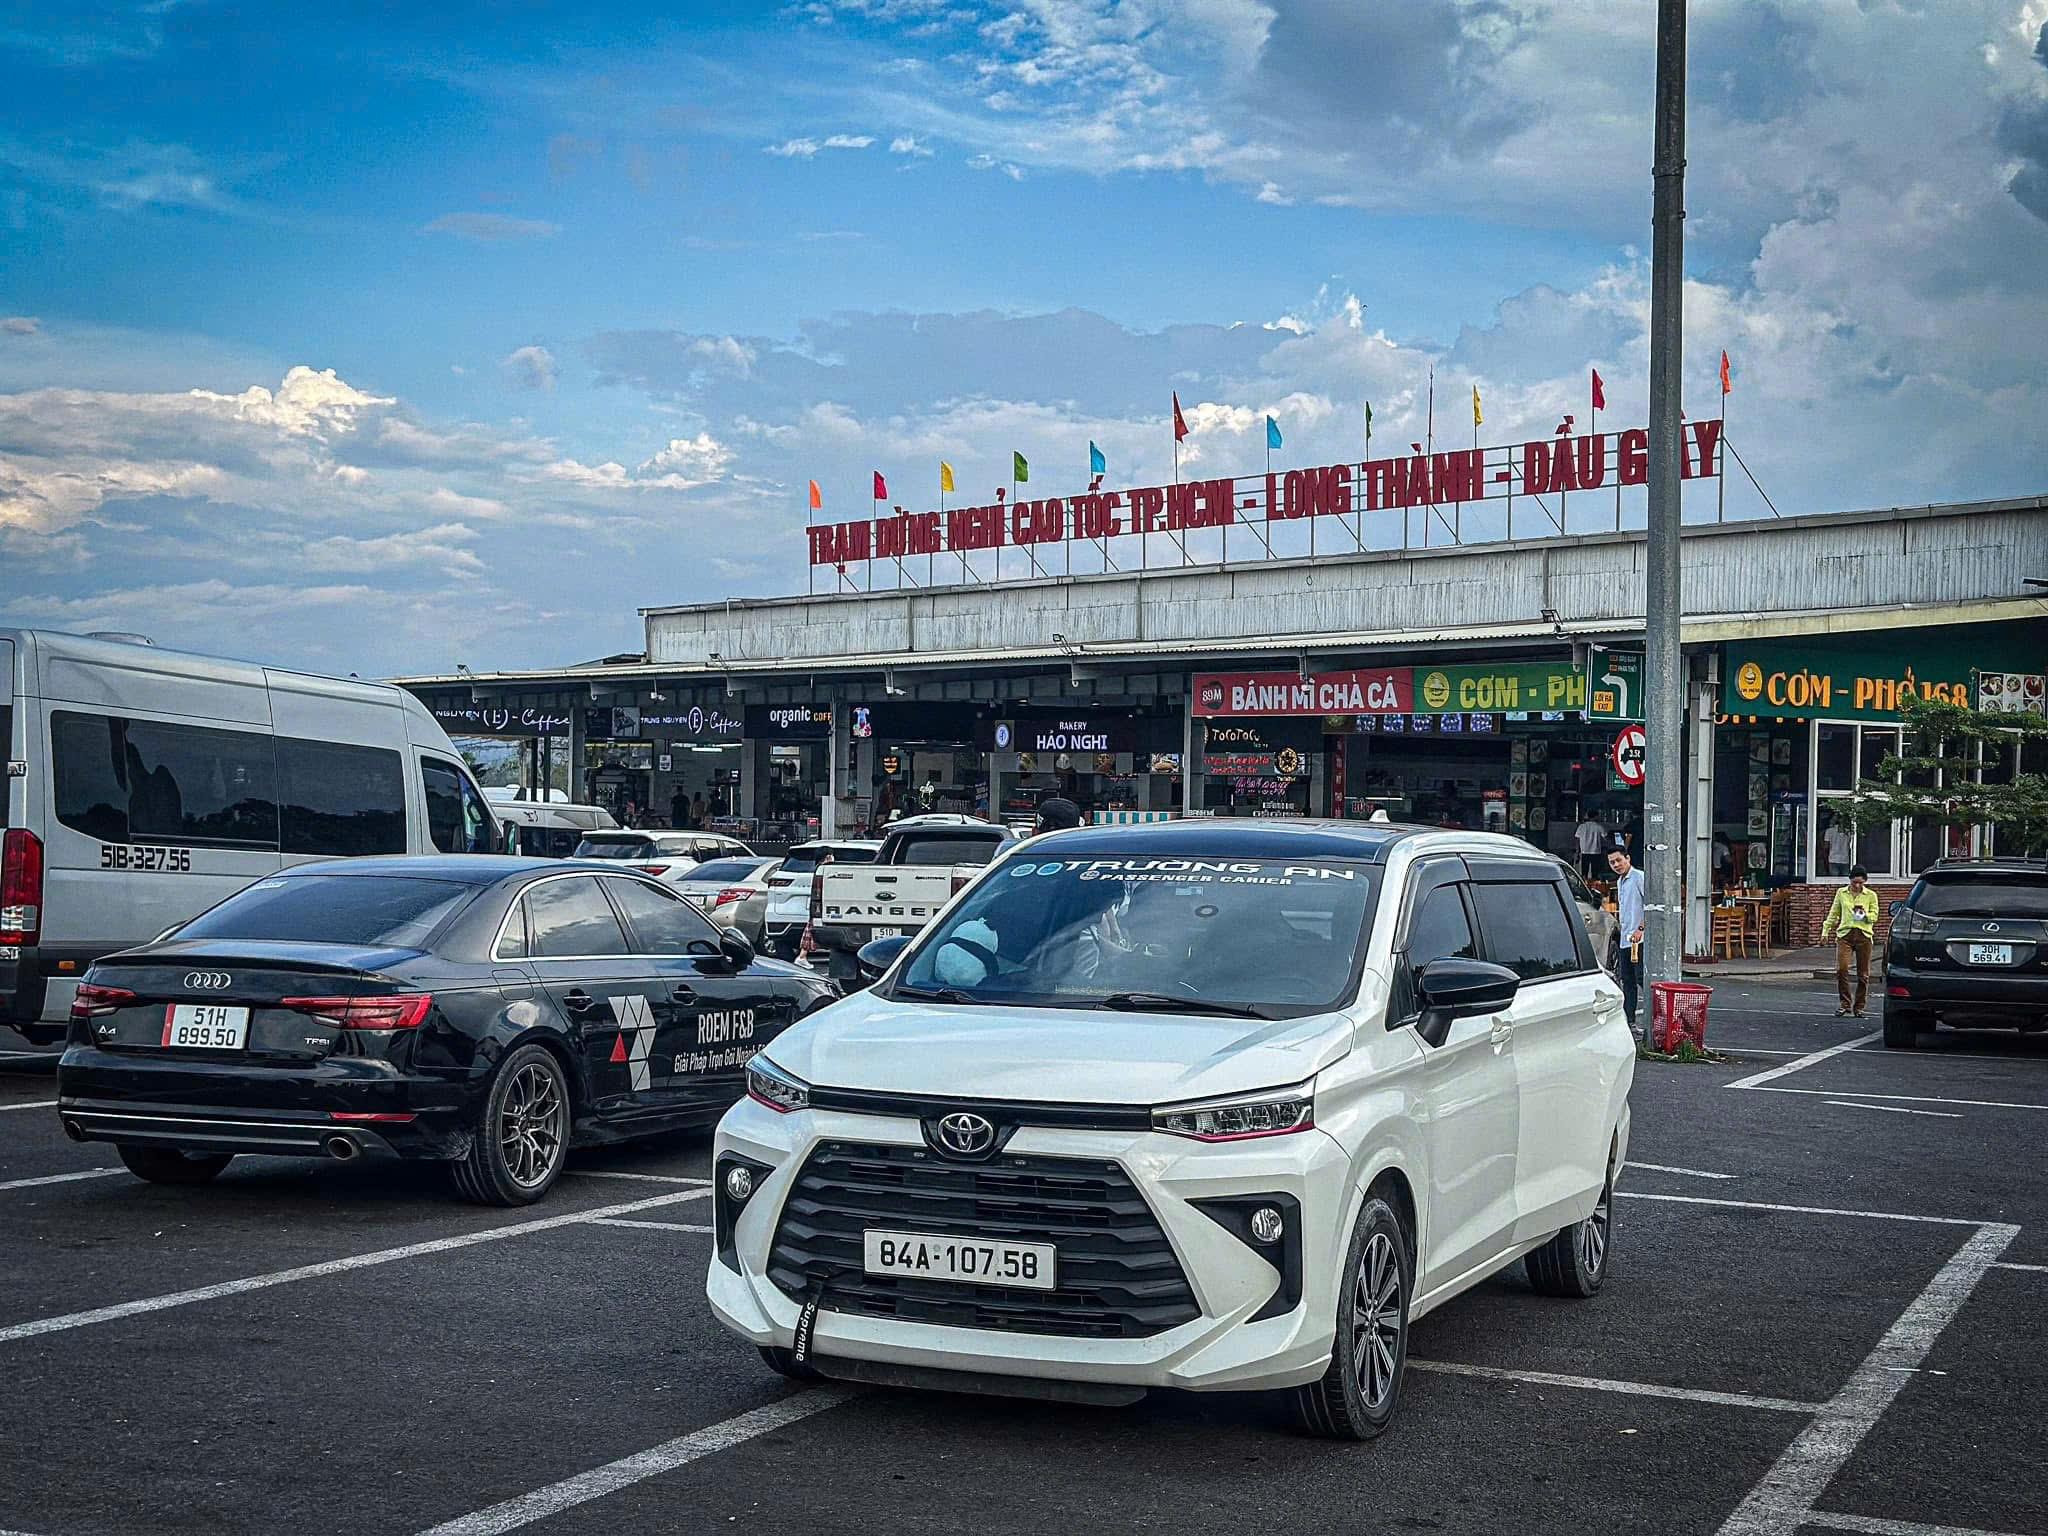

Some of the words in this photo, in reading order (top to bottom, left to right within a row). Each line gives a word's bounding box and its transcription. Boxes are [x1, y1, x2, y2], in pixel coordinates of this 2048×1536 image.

[806, 520, 871, 574] TRẠM
[1012, 498, 1064, 546] CAO
[1070, 475, 1121, 539] TỐC
[1127, 478, 1234, 534] TP.HCM
[1266, 464, 1351, 521] LONG
[1361, 442, 1484, 511] THÀNH
[1619, 411, 1724, 486] GY
[1232, 679, 1287, 711] BÁNH
[1368, 675, 1398, 709] CÁ
[1459, 674, 1519, 709] CƠM
[1548, 675, 1585, 707] PH
[1767, 668, 1831, 708] CƠM
[1920, 682, 1968, 710] 168
[769, 705, 811, 728] organic
[813, 712, 832, 722] COFF
[1059, 721, 1087, 731] BAKERY
[1071, 734, 1108, 750] NGHI
[1100, 873, 1212, 883] PASSENGER
[1284, 865, 1355, 880] AN
[1981, 945, 2000, 954] 30H
[195, 1008, 226, 1027] 51H
[697, 1012, 731, 1045] ROEM
[733, 1008, 755, 1040] F&B
[98, 1025, 117, 1036] A4
[178, 1026, 237, 1047] 899.50
[674, 1053, 689, 1073] Giải
[689, 1051, 707, 1075] Pháp
[879, 1240, 1038, 1280] 84A-107.58
